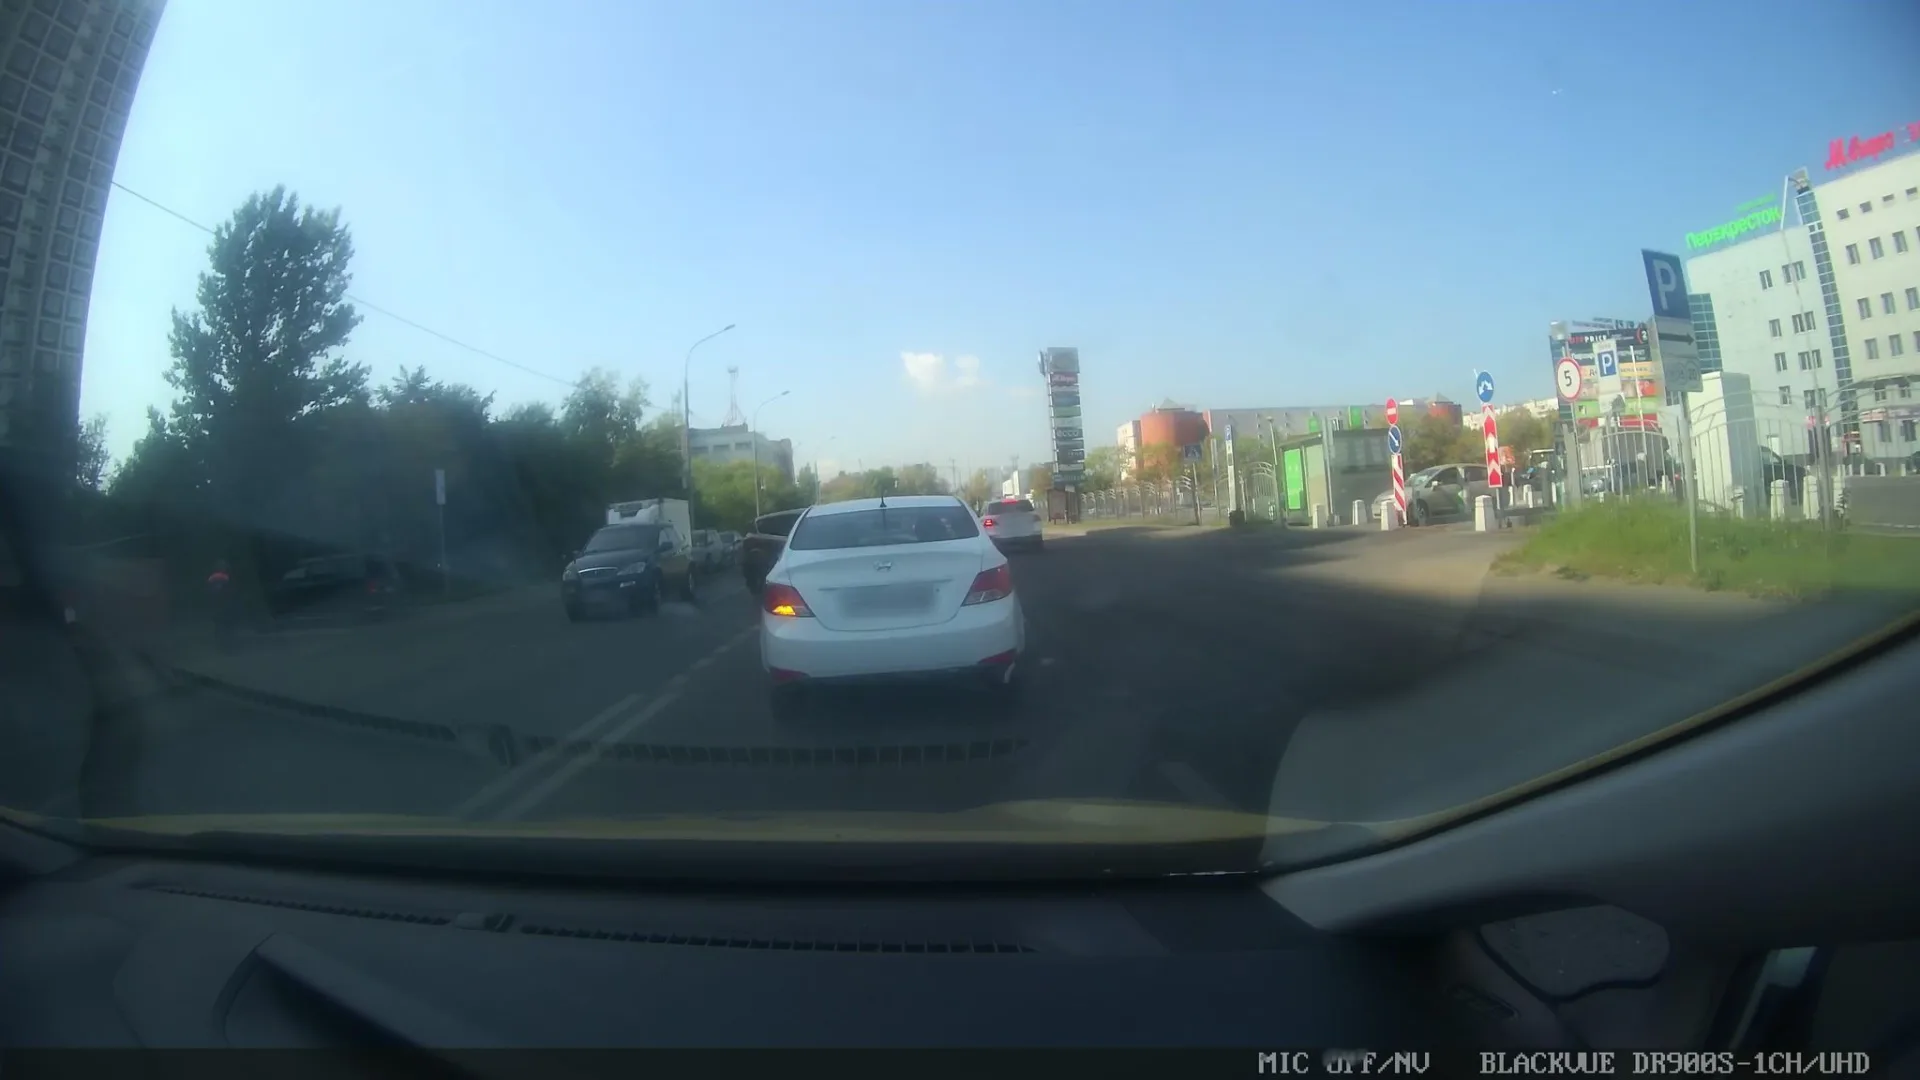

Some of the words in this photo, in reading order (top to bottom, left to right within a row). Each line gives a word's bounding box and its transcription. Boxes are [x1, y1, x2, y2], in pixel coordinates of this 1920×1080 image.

[1652, 258, 1677, 311] P
[1601, 354, 1612, 374] P
[1563, 370, 1572, 387] 5
